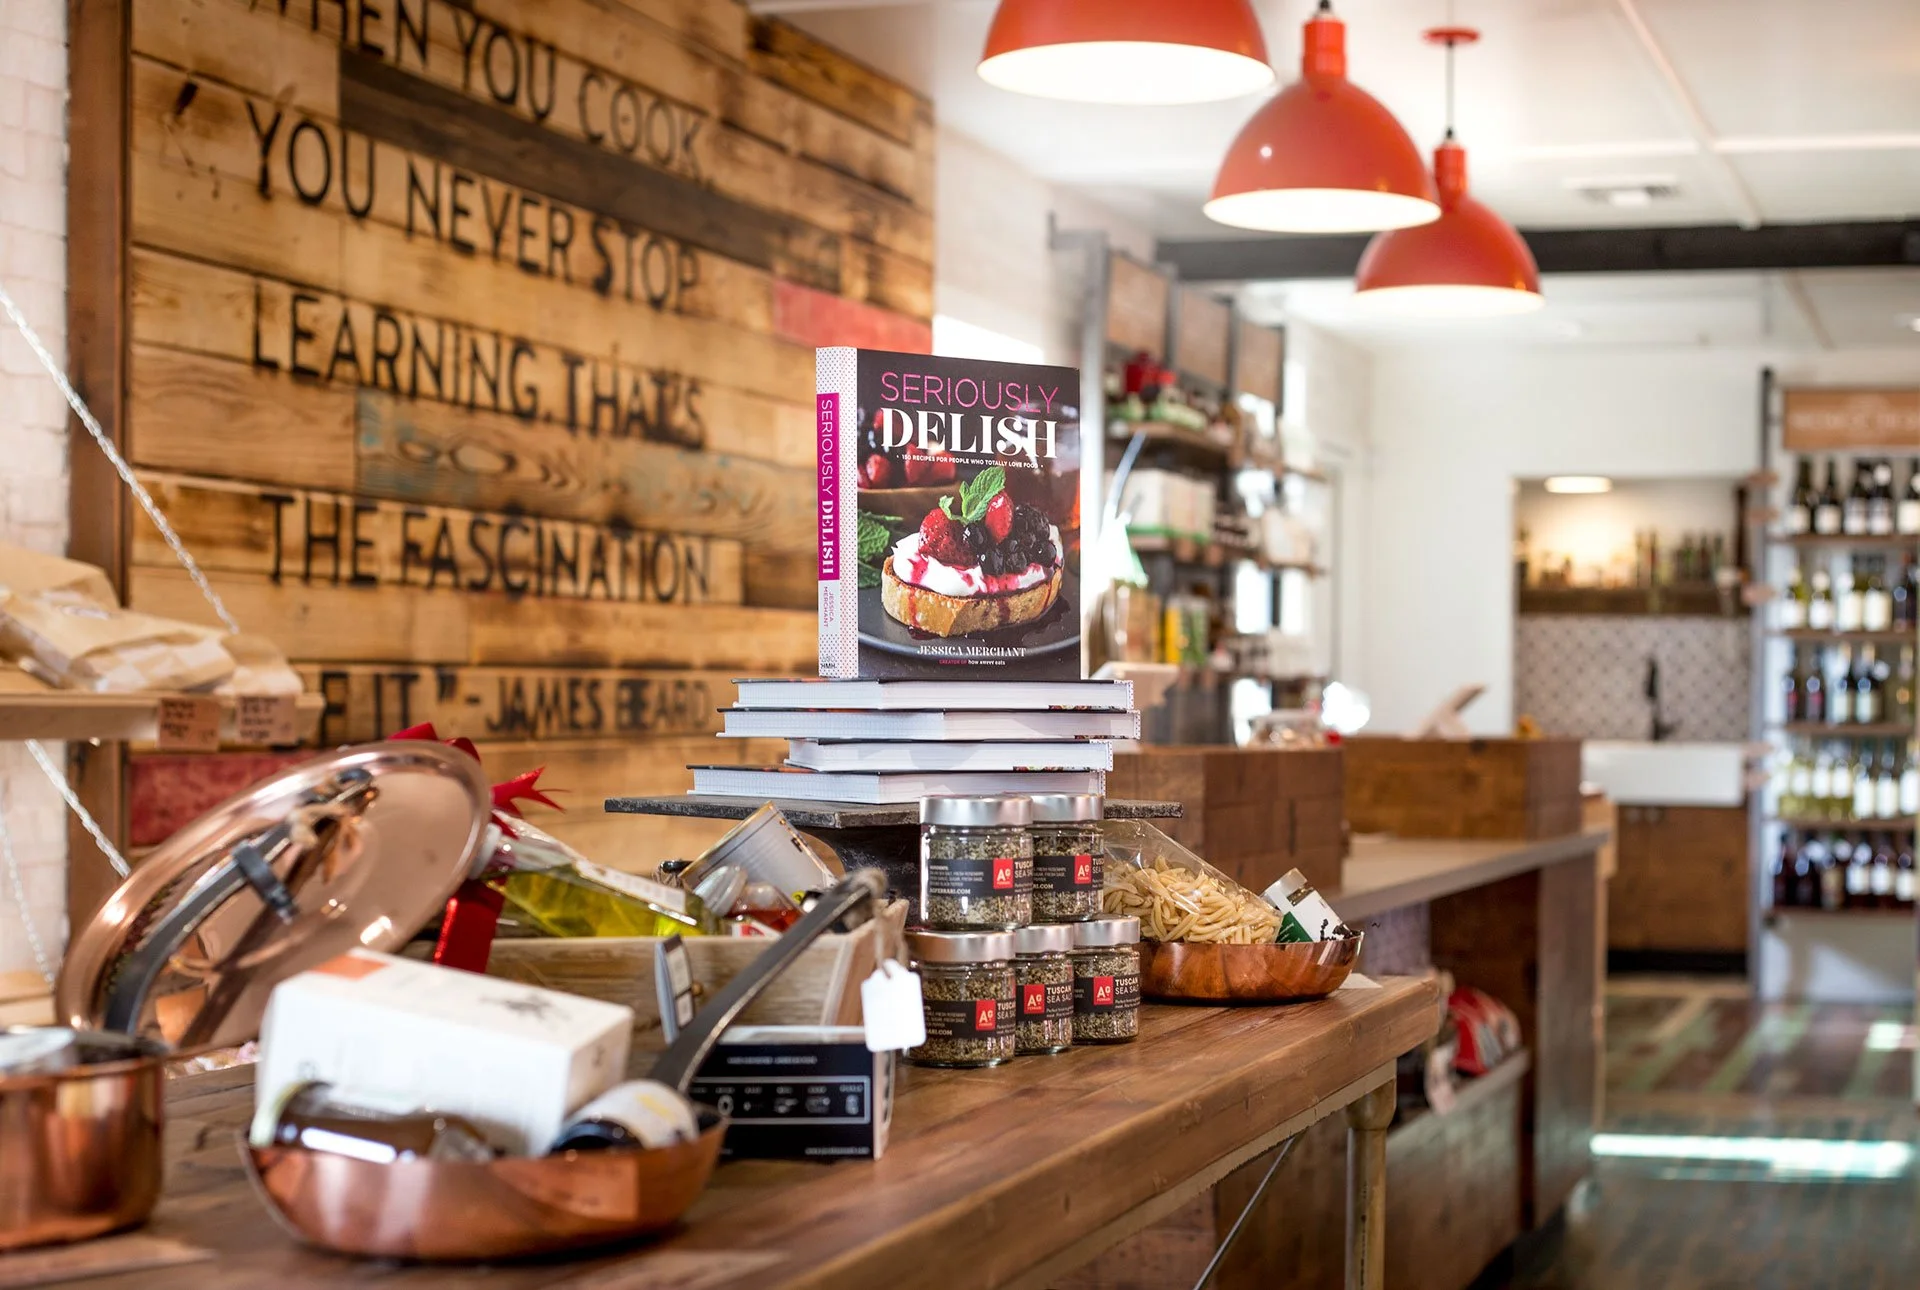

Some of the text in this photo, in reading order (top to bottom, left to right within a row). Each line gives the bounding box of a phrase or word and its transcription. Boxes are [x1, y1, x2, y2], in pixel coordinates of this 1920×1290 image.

[453, 8, 556, 121] YOU
[577, 72, 712, 184] COOK
[244, 100, 701, 312] YOU NEVER STOP
[881, 371, 1059, 414] SERIOUSLY
[821, 399, 833, 495] SERIOUSLY
[880, 407, 1058, 459] DELISH
[985, 459, 1007, 467] TOTALLY
[259, 495, 709, 603] THE FASCINATION
[822, 500, 834, 573] DELISH
[917, 645, 1027, 657] JESSICA MERCHANT
[1046, 985, 1071, 995] TUSCAN
[1046, 995, 1060, 1004] SEA
[1115, 977, 1138, 987] TUSCAN
[1115, 986, 1128, 995] SEA
